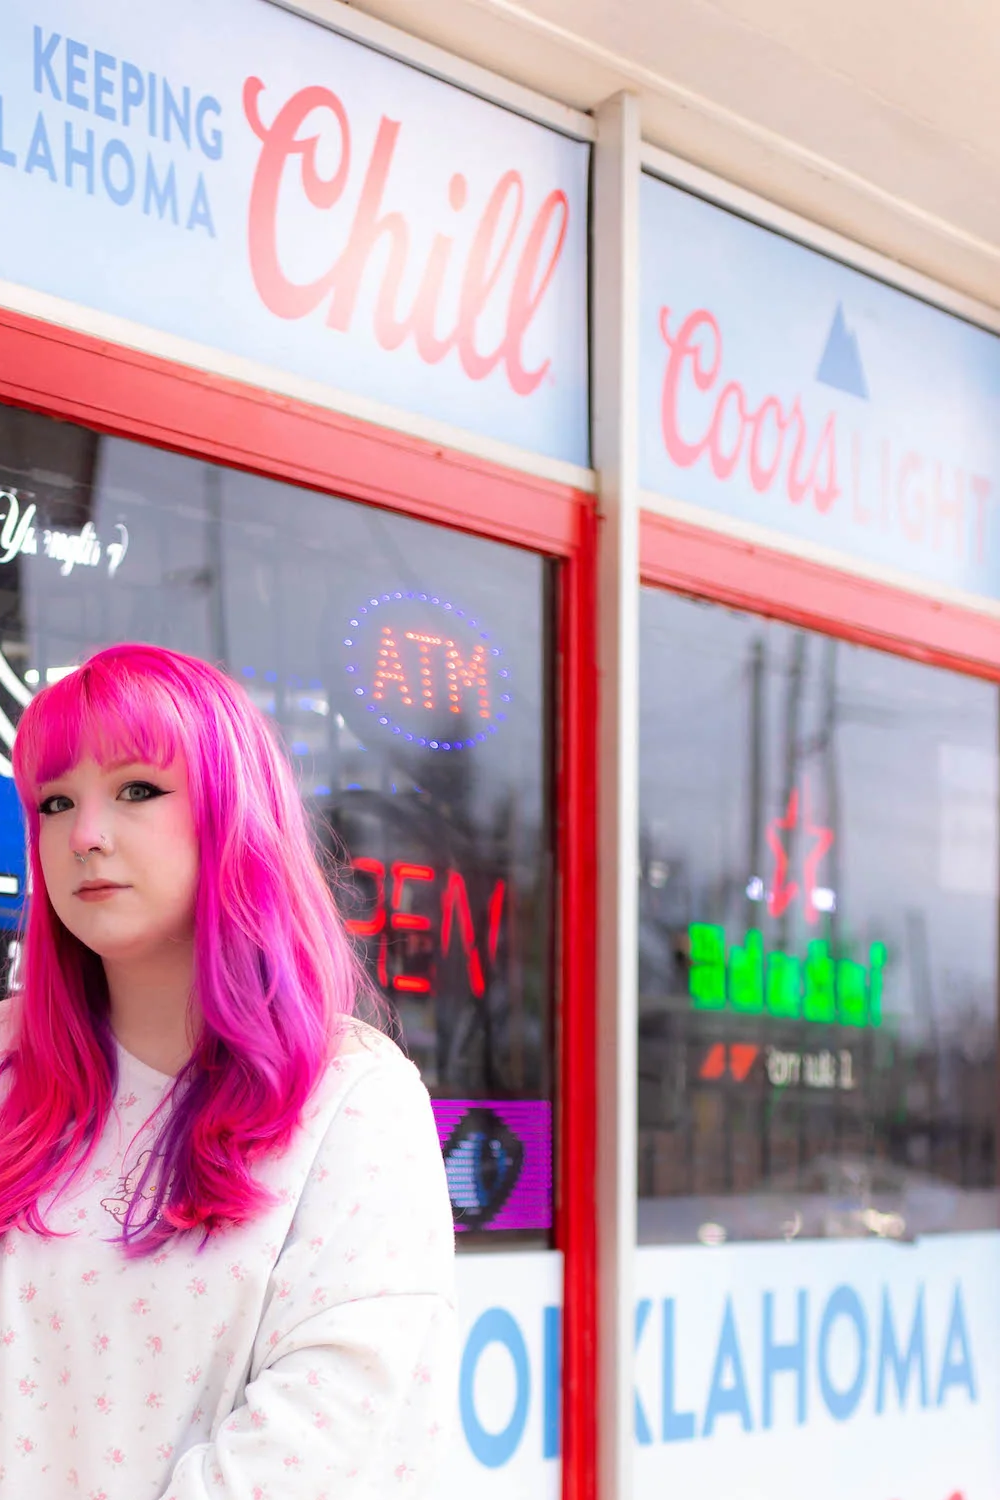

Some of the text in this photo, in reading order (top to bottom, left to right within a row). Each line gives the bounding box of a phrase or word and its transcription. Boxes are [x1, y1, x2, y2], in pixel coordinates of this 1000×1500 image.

[33, 25, 223, 161] KEEPING
[242, 76, 569, 396] Chill
[659, 305, 998, 566] Coors LIGHT
[373, 626, 490, 718] ATM
[345, 857, 505, 998] PEN
